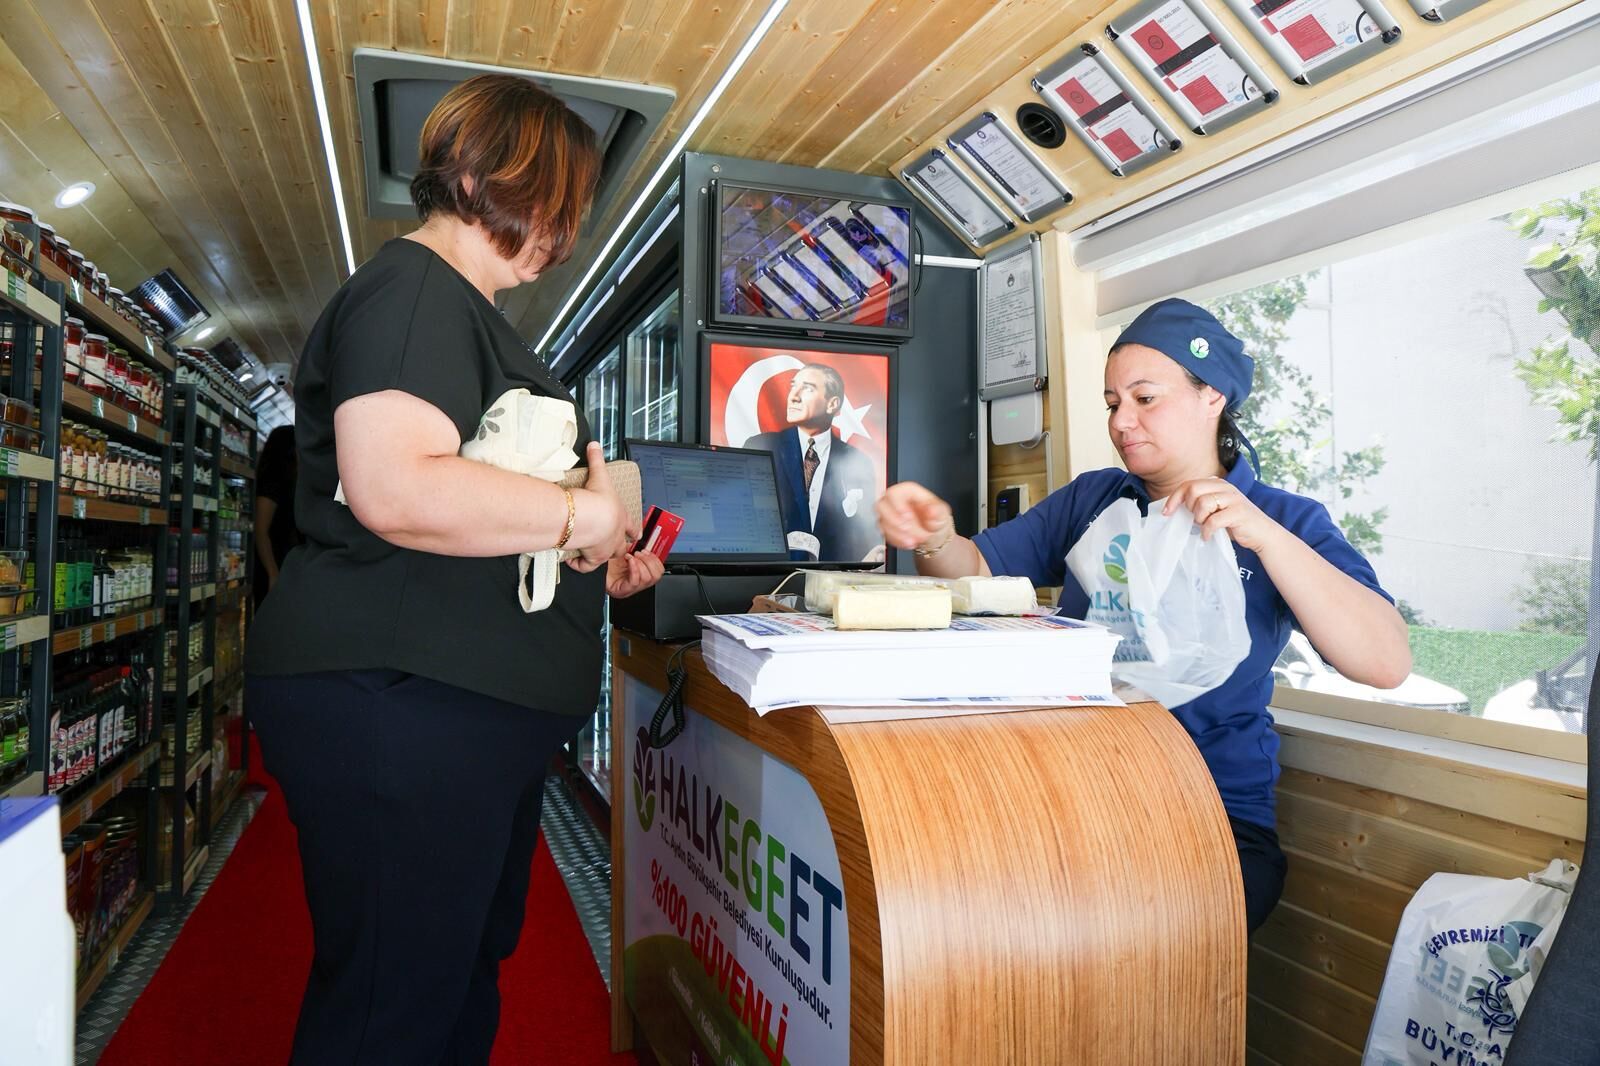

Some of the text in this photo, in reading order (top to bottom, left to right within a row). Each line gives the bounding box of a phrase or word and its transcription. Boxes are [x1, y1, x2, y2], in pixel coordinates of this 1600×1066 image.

[651, 858, 789, 1066] %100 GÜVENLİ
[723, 890, 763, 950] Belediyesi
[765, 934, 833, 1030] Kuruluşudur.
[1426, 925, 1505, 958] ÇEVREMİZİ
